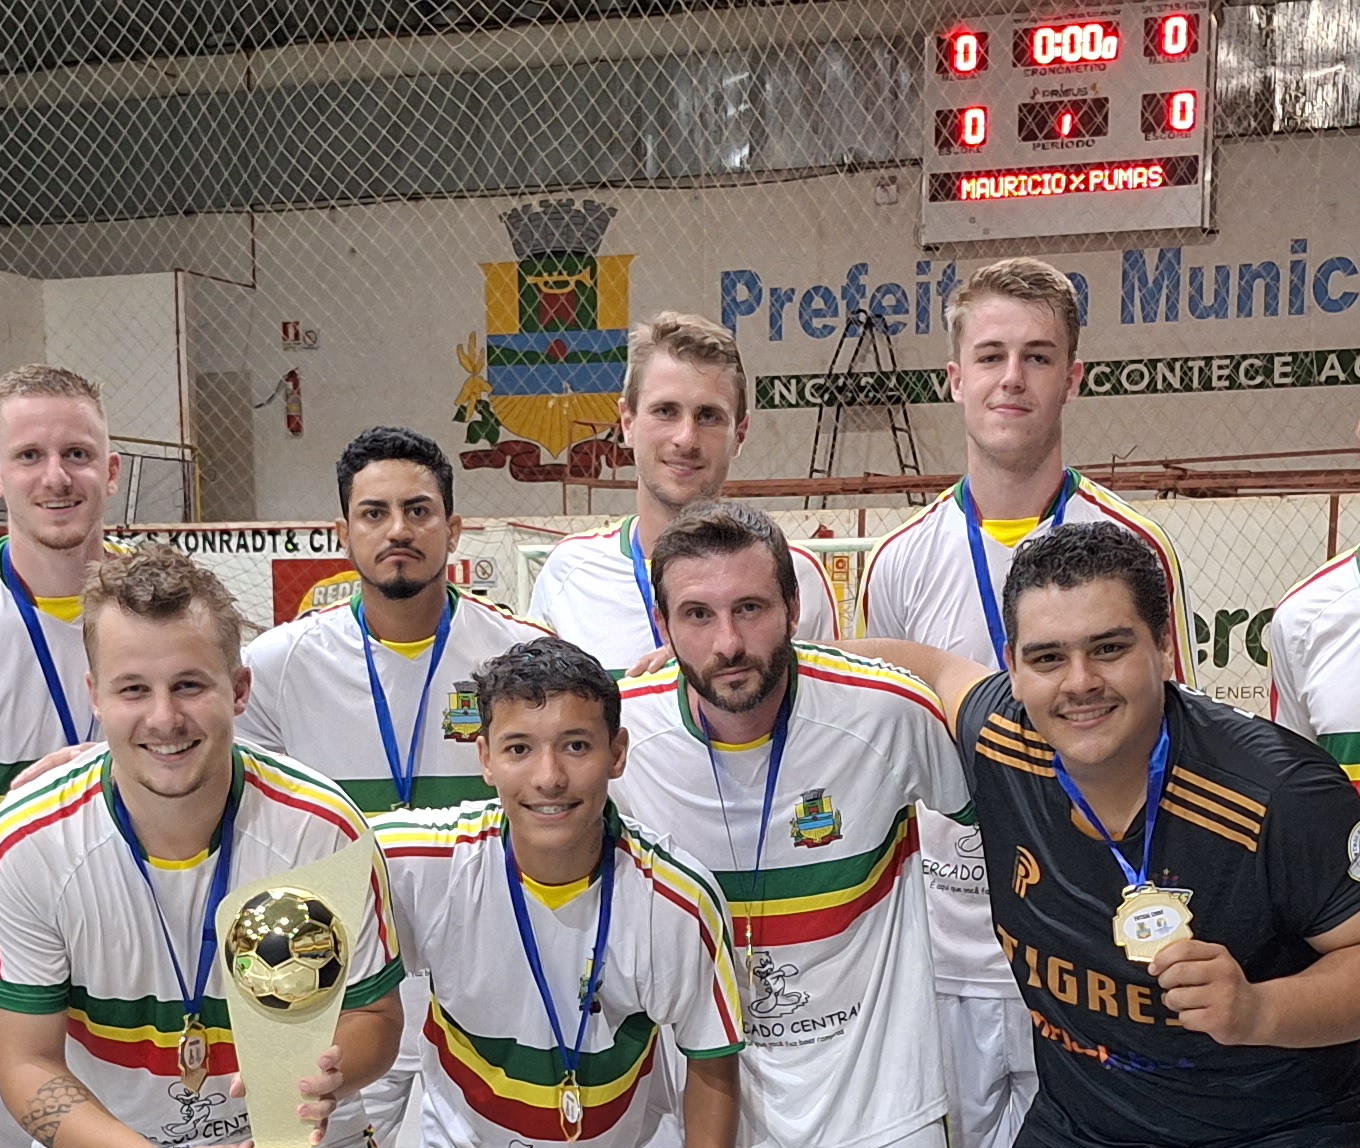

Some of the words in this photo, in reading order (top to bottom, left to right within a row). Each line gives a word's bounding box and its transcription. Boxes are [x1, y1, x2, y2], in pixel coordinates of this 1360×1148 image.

[961, 172, 1066, 200] MAURICIO
[1090, 165, 1164, 192] PUMAS
[720, 260, 1089, 342] Prefeit
[1088, 356, 1294, 394] CONTECE
[1215, 685, 1270, 700] ENER
[921, 858, 985, 881] ERCADO
[742, 1022, 785, 1038] CADO
